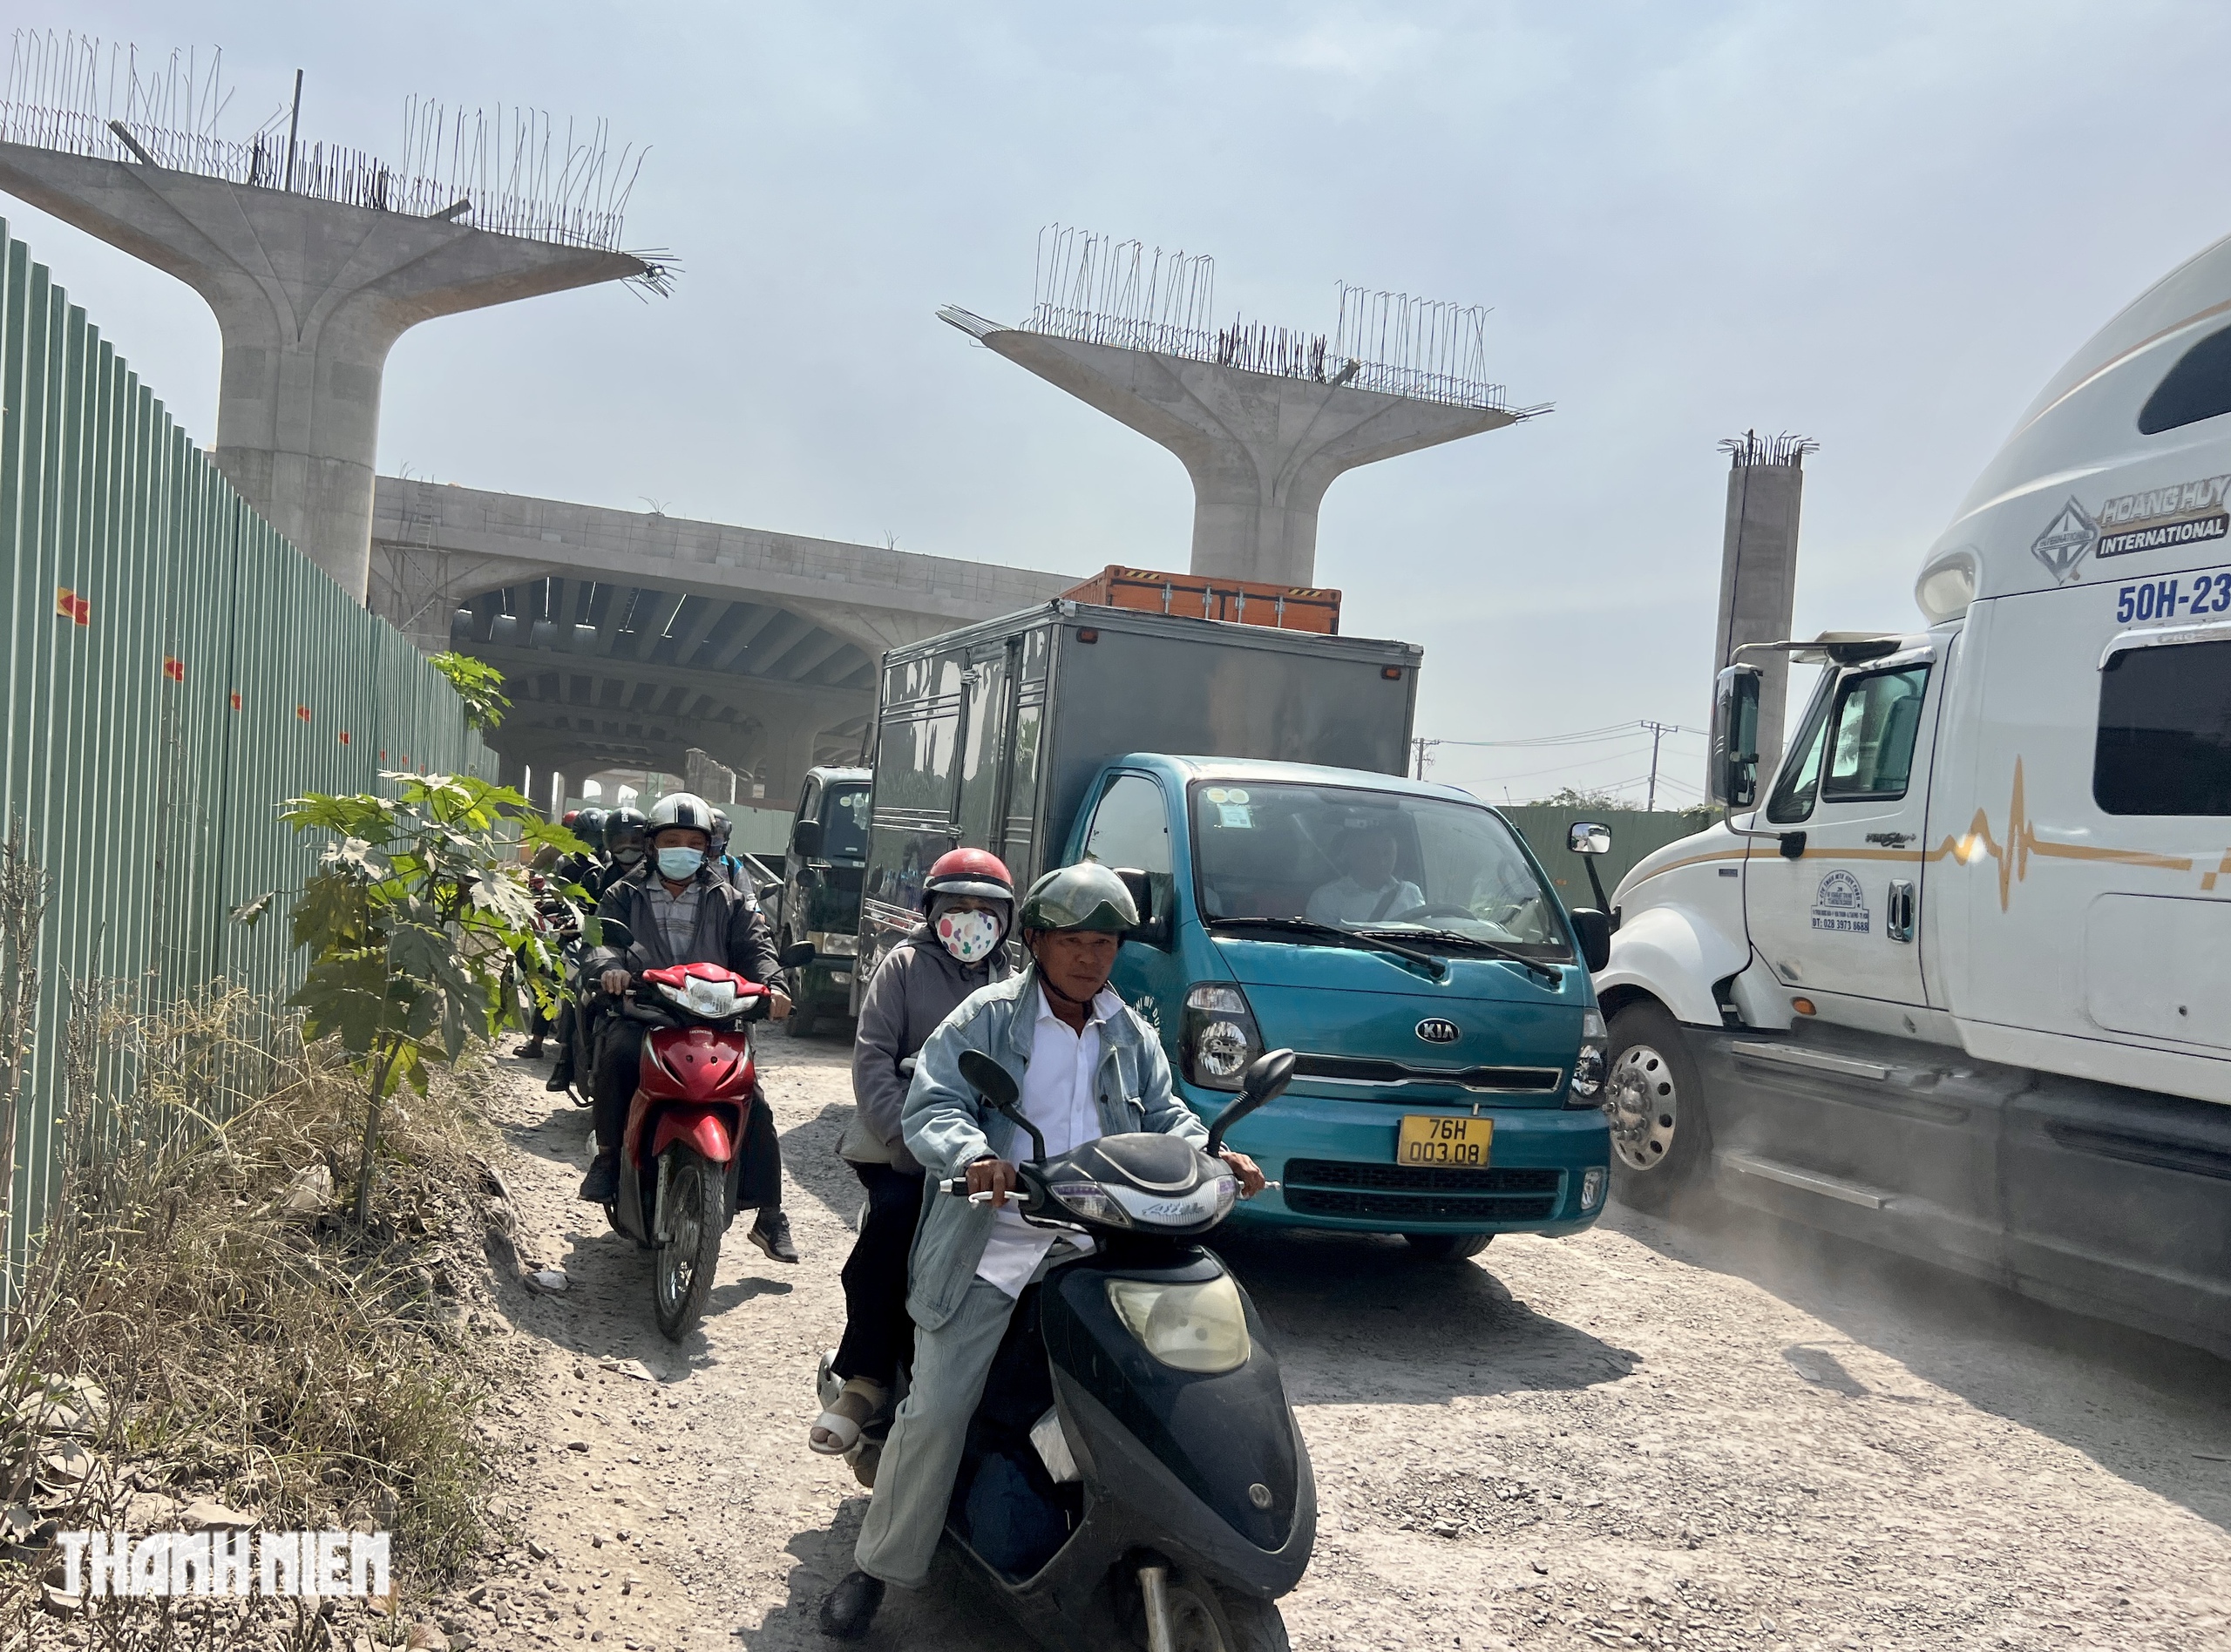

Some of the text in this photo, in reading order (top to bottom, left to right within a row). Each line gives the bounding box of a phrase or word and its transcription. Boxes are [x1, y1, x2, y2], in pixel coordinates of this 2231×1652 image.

[2100, 518, 2224, 555] INTERNATIONAL
[1823, 918, 1834, 929] 028
[1836, 919, 1851, 931] 3973
[1423, 1022, 1455, 1039] KIA
[1429, 1119, 1467, 1141] 76H
[1409, 1141, 1480, 1164] 003.08
